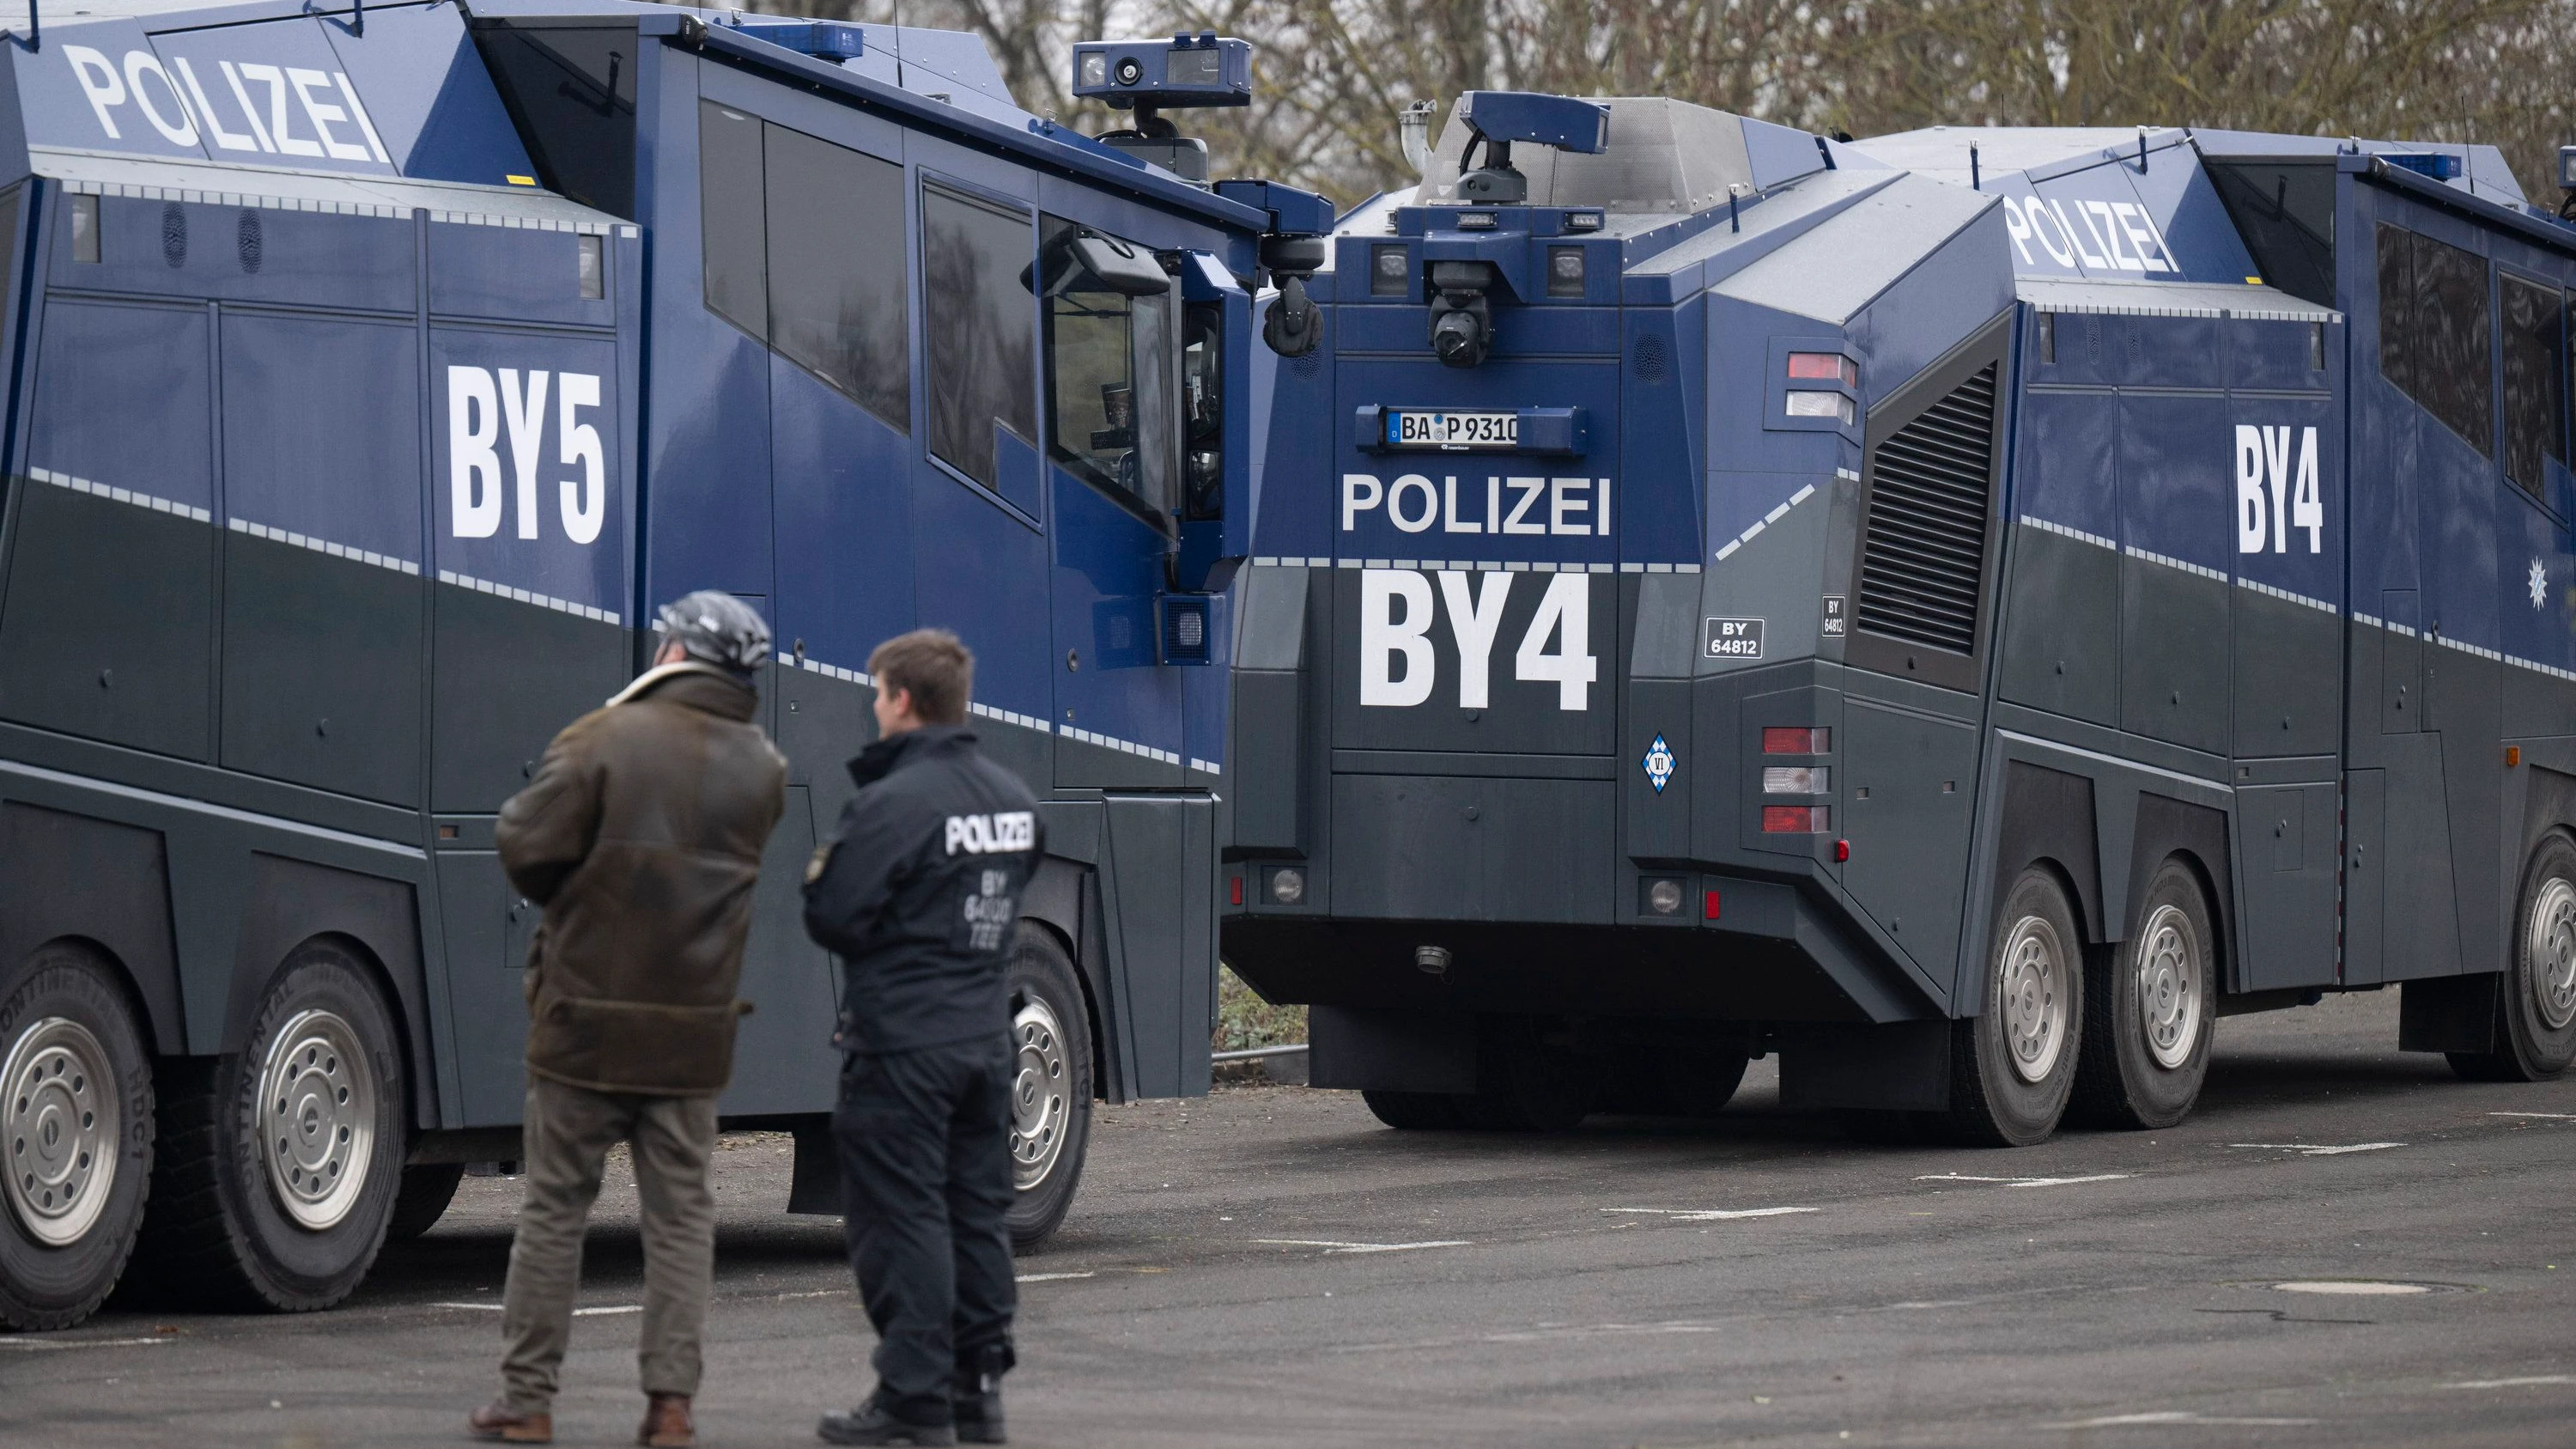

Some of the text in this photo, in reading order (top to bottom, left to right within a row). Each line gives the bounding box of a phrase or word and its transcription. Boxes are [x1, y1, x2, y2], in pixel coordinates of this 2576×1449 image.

[62, 44, 391, 163] POLIZEI
[2003, 194, 2180, 273] POLIZEI
[1401, 416, 1431, 441] BA
[1446, 417, 1461, 441] P
[447, 364, 605, 545] BY5
[1341, 473, 1611, 536] POLIZEI
[2235, 423, 2323, 554] BY4
[1722, 622, 1747, 636] BY
[1824, 618, 1843, 633] 64812
[1828, 600, 1839, 614] BY
[1359, 569, 1597, 711] BY4
[1710, 639, 1757, 654] 64812
[1654, 757, 1664, 770] VI
